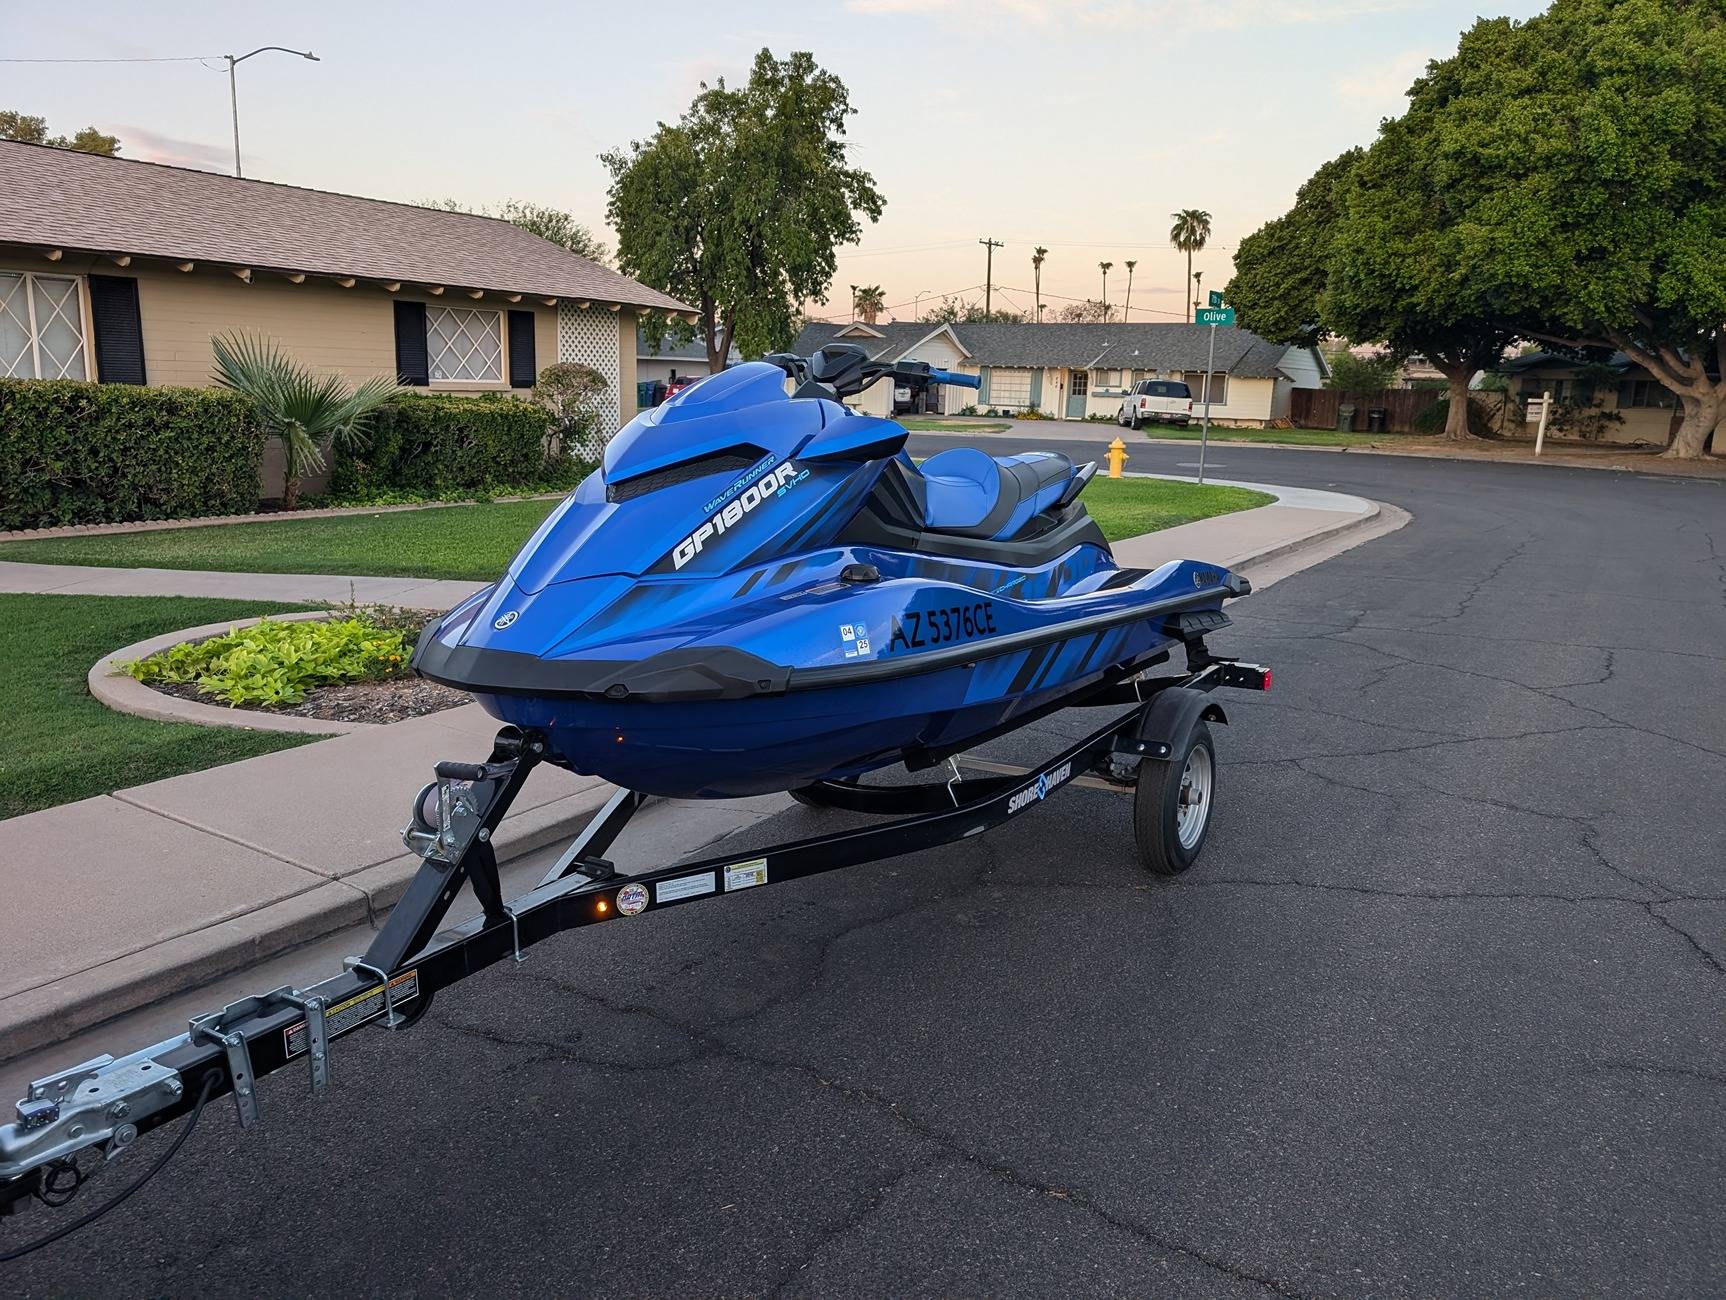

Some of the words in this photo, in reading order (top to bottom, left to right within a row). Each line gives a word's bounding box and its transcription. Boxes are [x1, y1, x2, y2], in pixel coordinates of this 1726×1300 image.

[1203, 312, 1227, 321] Olive
[703, 455, 775, 513] WAVERUNNER
[777, 469, 810, 498] SVHO
[672, 461, 798, 571] GP1800R
[842, 627, 852, 636] 04
[889, 611, 926, 652] AZ
[927, 602, 997, 644] 5376CE
[858, 640, 868, 649] 25
